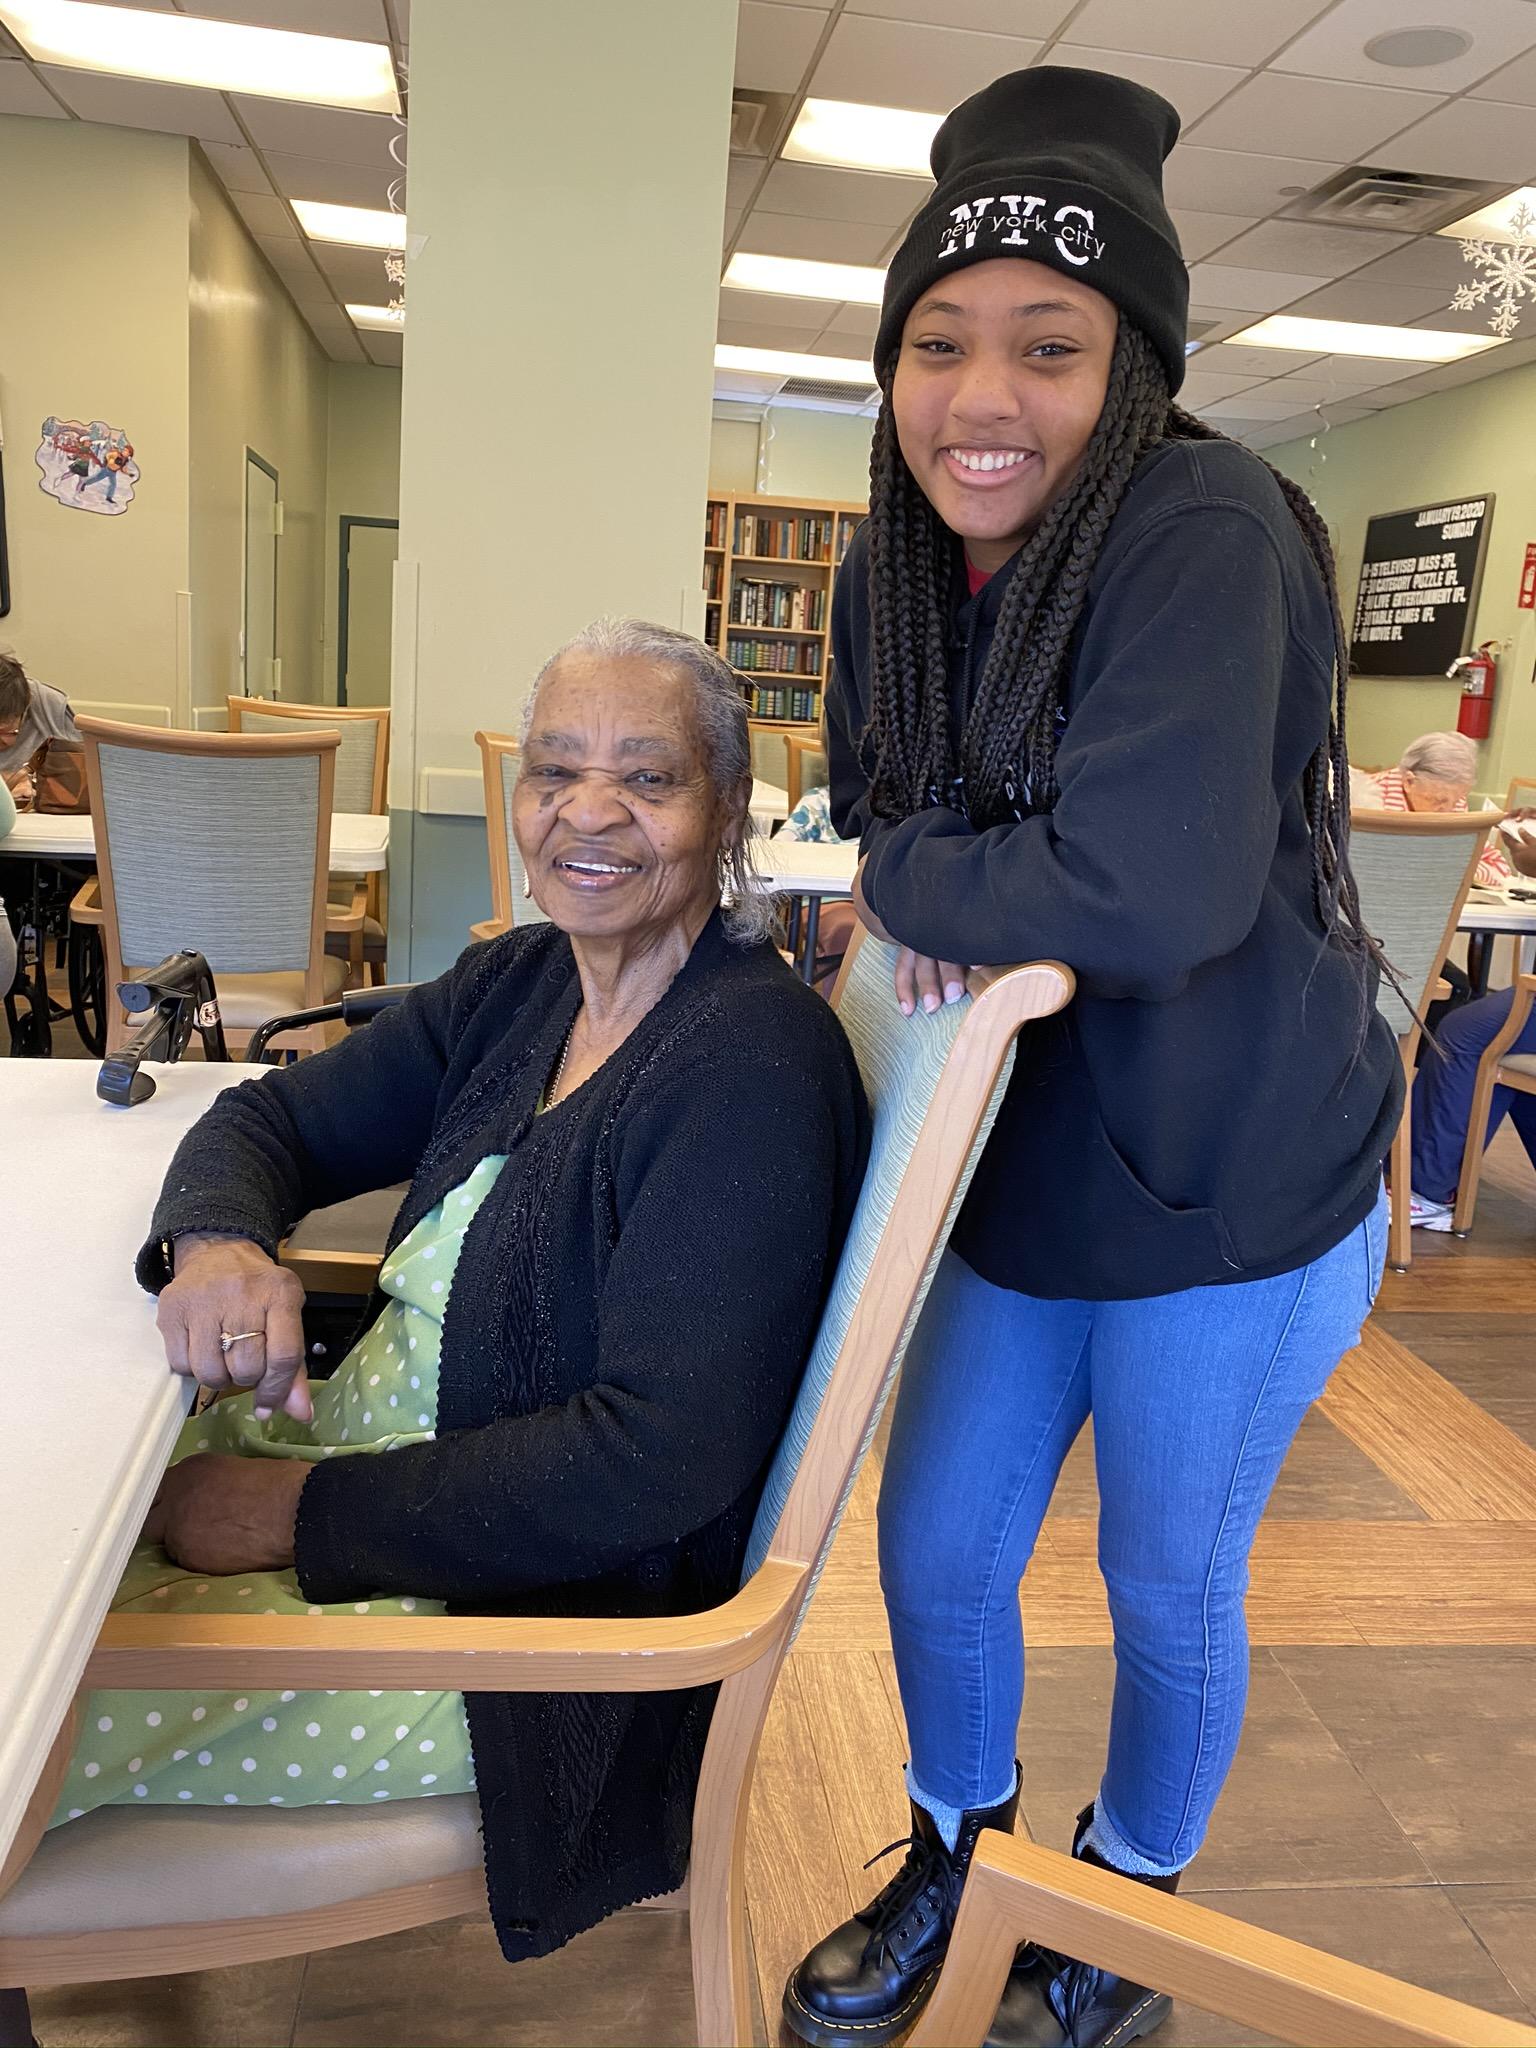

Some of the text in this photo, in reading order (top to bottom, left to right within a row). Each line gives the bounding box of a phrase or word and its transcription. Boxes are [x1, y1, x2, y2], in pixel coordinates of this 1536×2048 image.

[938, 195, 1095, 266] NYC
[940, 214, 1106, 260] new york city
[1441, 519, 1478, 540] SUNDAY
[1379, 557, 1417, 578] TELEVISED
[1417, 554, 1441, 572] MASS
[1376, 575, 1413, 593] CATEGORY
[1412, 571, 1445, 589] PUZZLE
[1374, 593, 1392, 609] LIVE
[1391, 588, 1453, 608] ENTERTAINMENT
[1371, 609, 1394, 625] TABLE
[1394, 607, 1421, 624] GAMES
